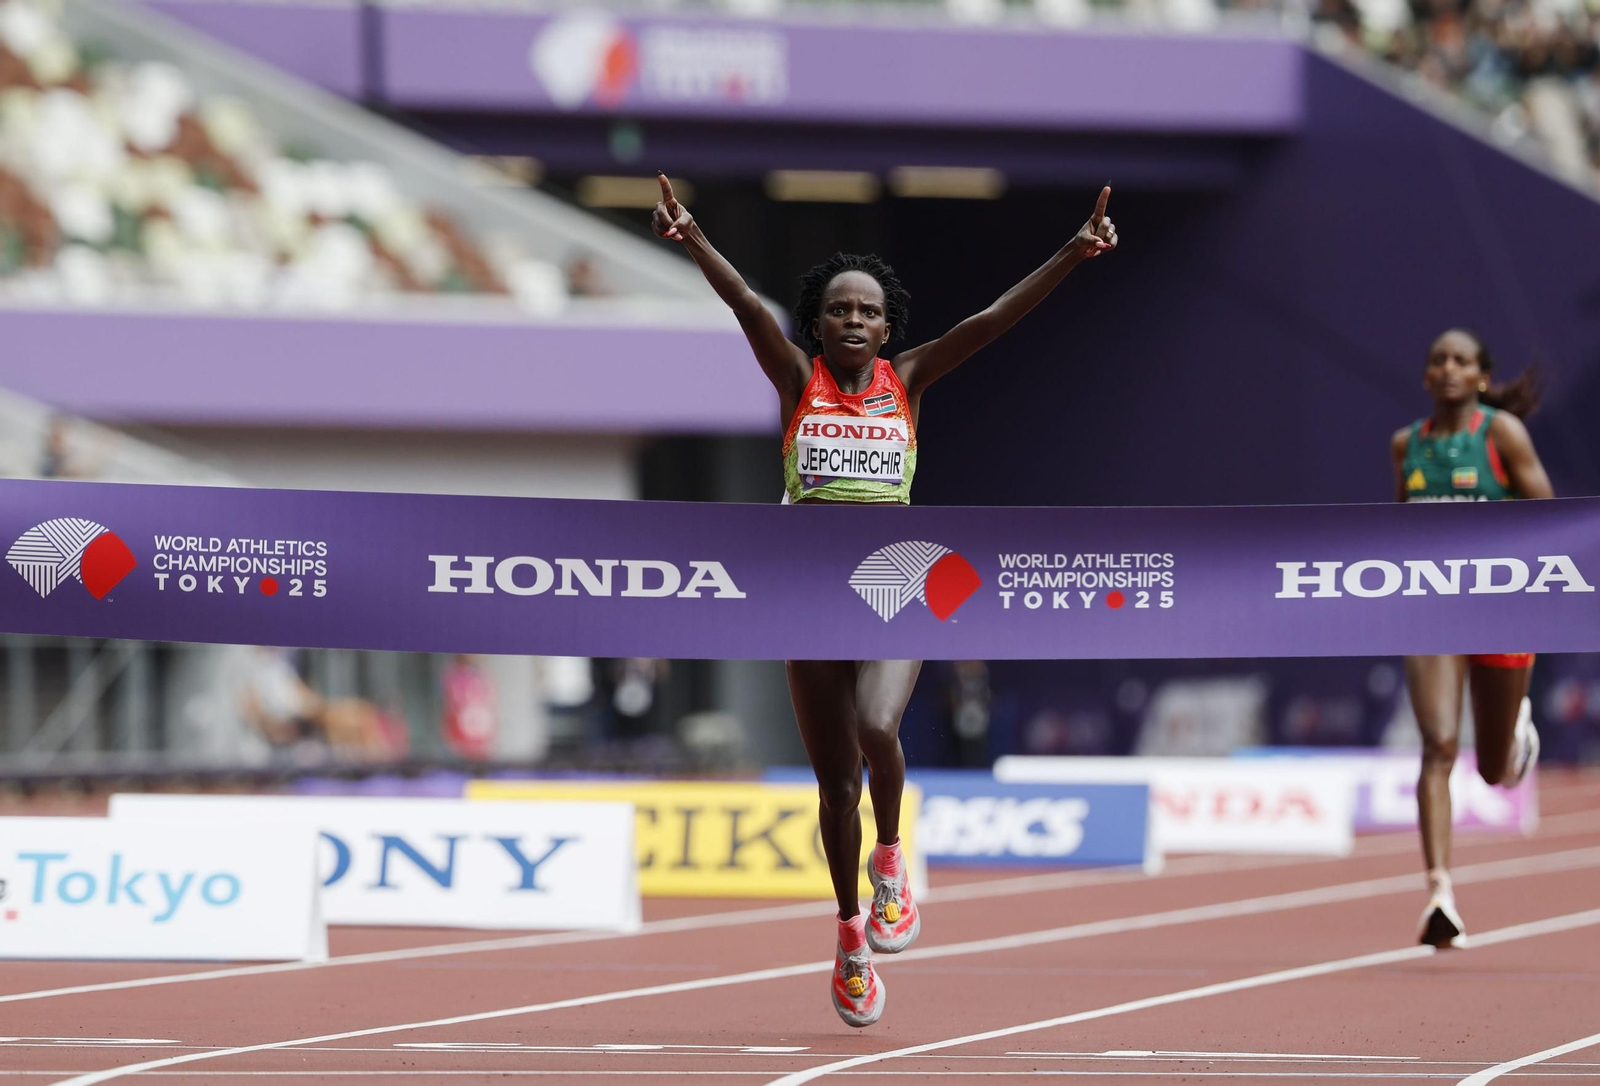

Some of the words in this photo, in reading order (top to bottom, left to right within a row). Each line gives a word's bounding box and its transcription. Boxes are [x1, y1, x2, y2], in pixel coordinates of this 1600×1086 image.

[800, 422, 906, 441] HONDA
[801, 447, 901, 475] JEPCHIRCHIR
[153, 534, 222, 554] WORLD
[225, 537, 328, 557] ATHLETICS
[153, 553, 328, 577] CHAMPIONSHIPS
[998, 552, 1068, 569] WORLD
[1071, 552, 1175, 569] ATHLETICS
[427, 554, 747, 599] HONDA
[997, 570, 1175, 589] CHAMPIONSHIPS
[1275, 554, 1596, 599] HONDA
[17, 850, 242, 925] Tokyo
